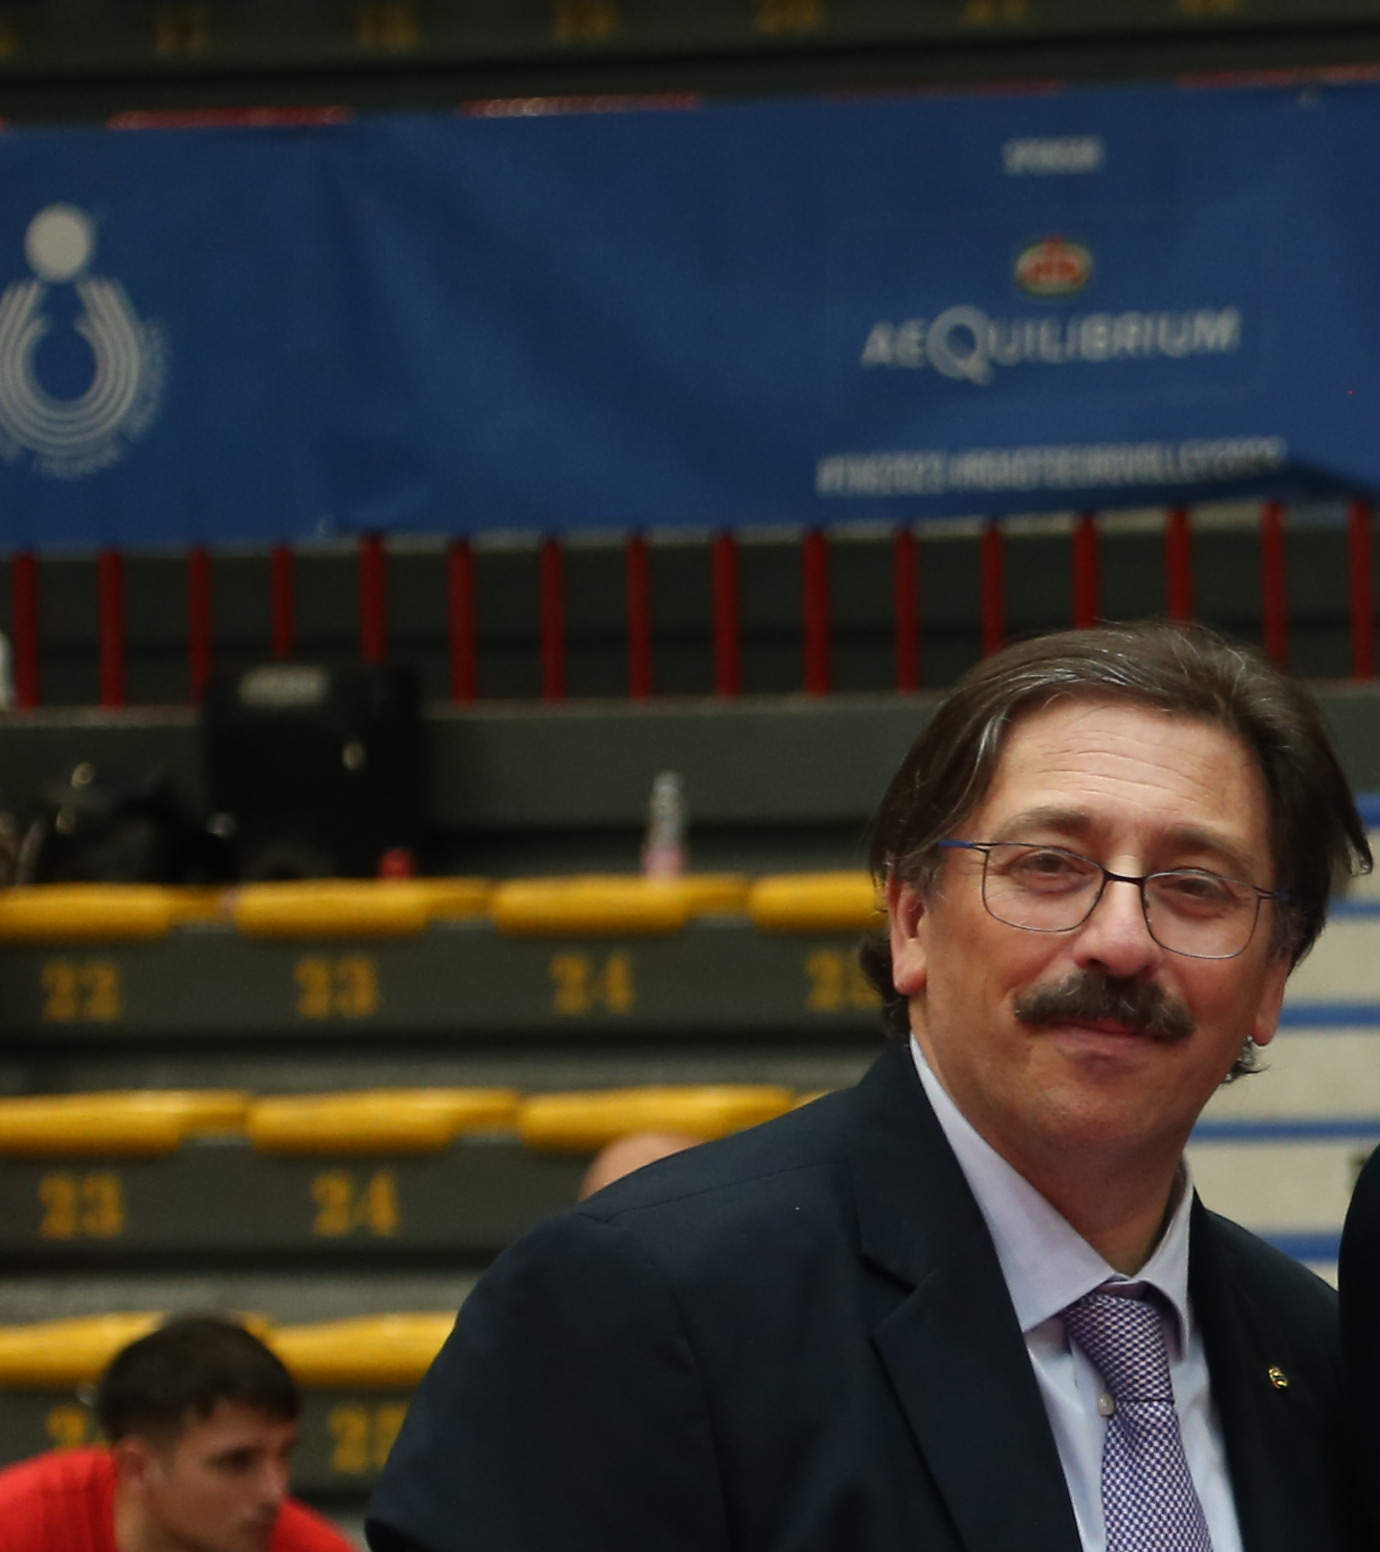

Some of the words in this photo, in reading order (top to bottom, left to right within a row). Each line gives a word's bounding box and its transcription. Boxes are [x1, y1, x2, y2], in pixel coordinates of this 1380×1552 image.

[861, 305, 1241, 384] AEQUILIBRIUM
[551, 951, 634, 1016] 24
[311, 1169, 397, 1238] 24
